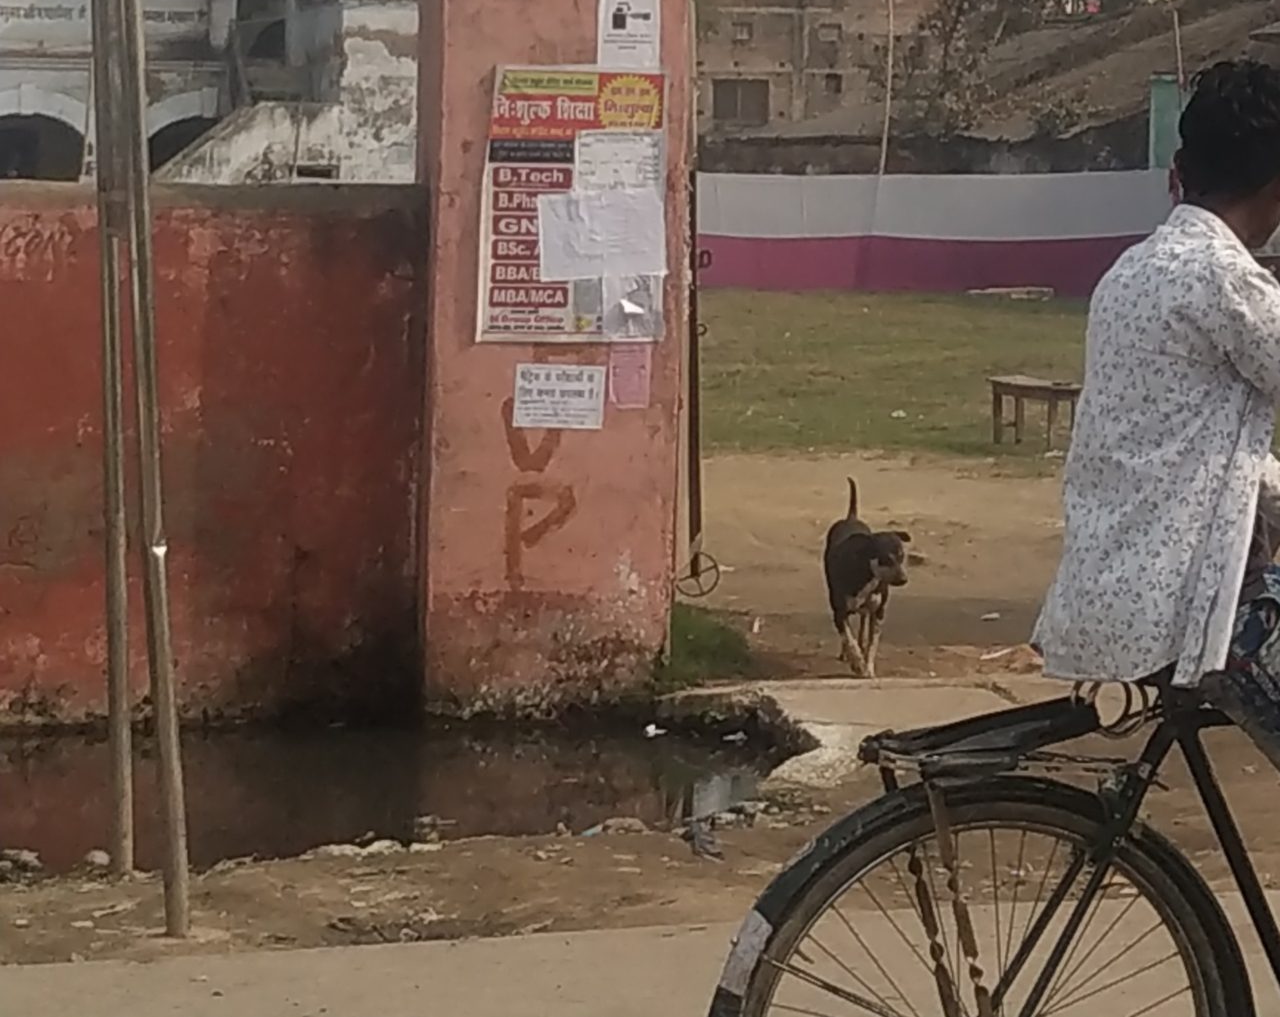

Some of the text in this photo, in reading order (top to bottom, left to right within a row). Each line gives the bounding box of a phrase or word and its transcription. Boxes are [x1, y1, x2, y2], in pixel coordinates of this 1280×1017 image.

[498, 168, 565, 184] B.Tech
[498, 192, 539, 210] B.Pha
[498, 217, 539, 234] GN
[492, 289, 565, 304] MBA/MCA
